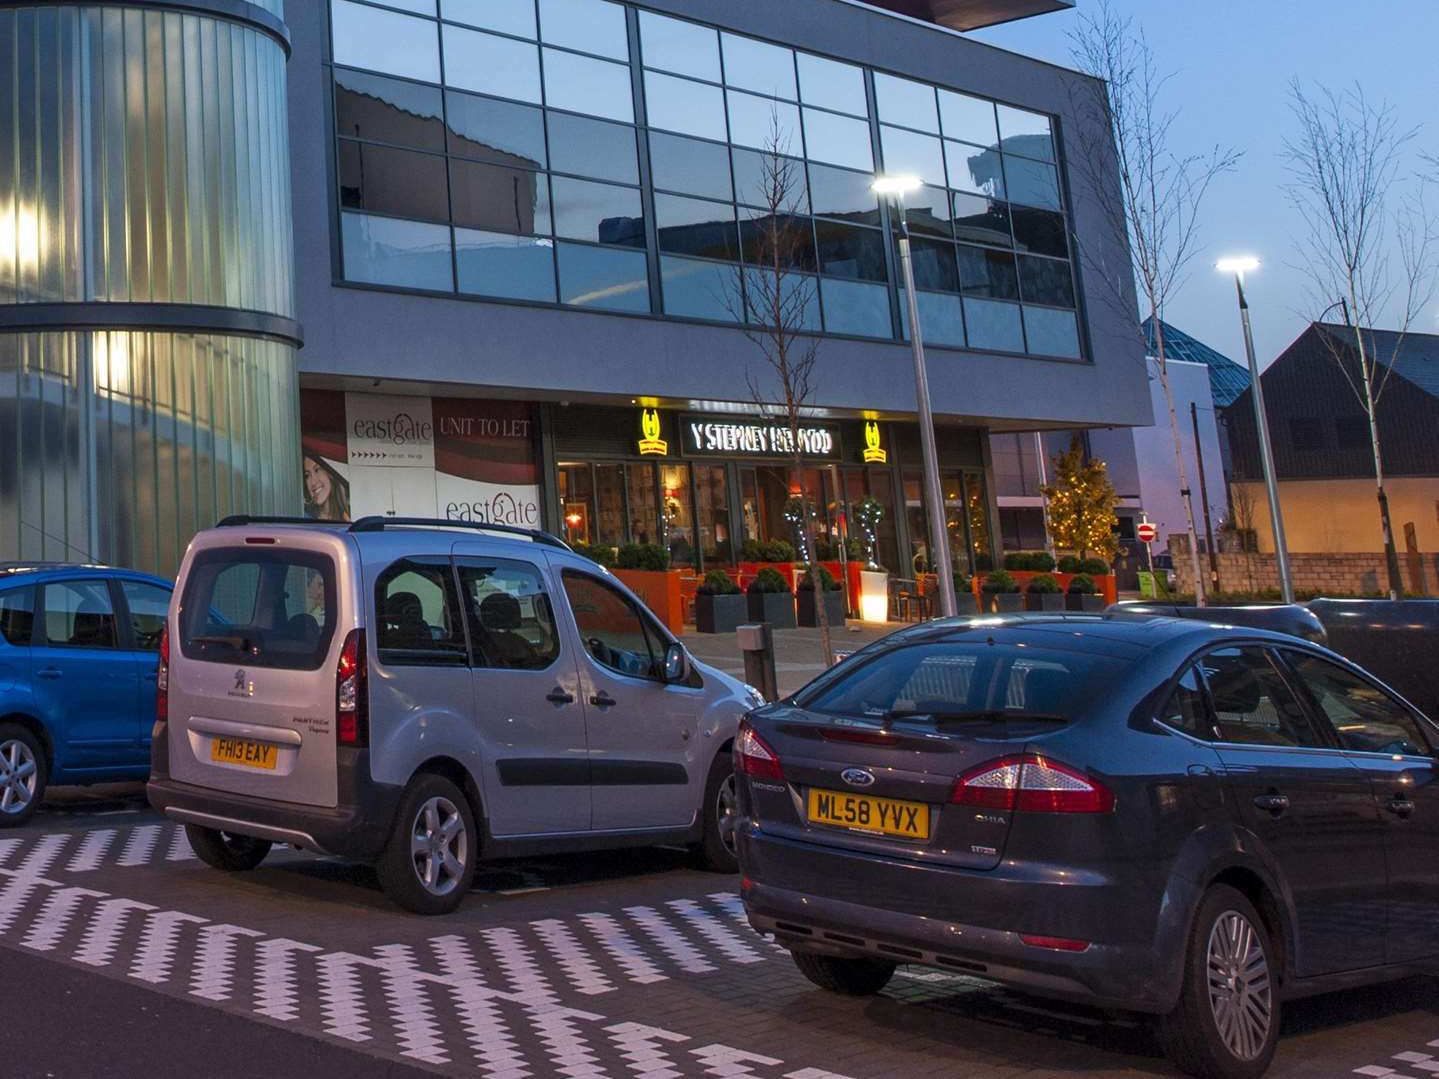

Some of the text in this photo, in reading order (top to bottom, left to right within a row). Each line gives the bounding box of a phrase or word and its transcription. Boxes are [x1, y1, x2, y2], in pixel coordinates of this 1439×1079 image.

[354, 413, 433, 446] eastgate
[440, 417, 530, 438] UNIT TO LET
[691, 423, 703, 449] Y
[446, 492, 537, 525] eastgate
[218, 739, 270, 764] FH13 EAY
[817, 793, 919, 833] ML58 YVX
